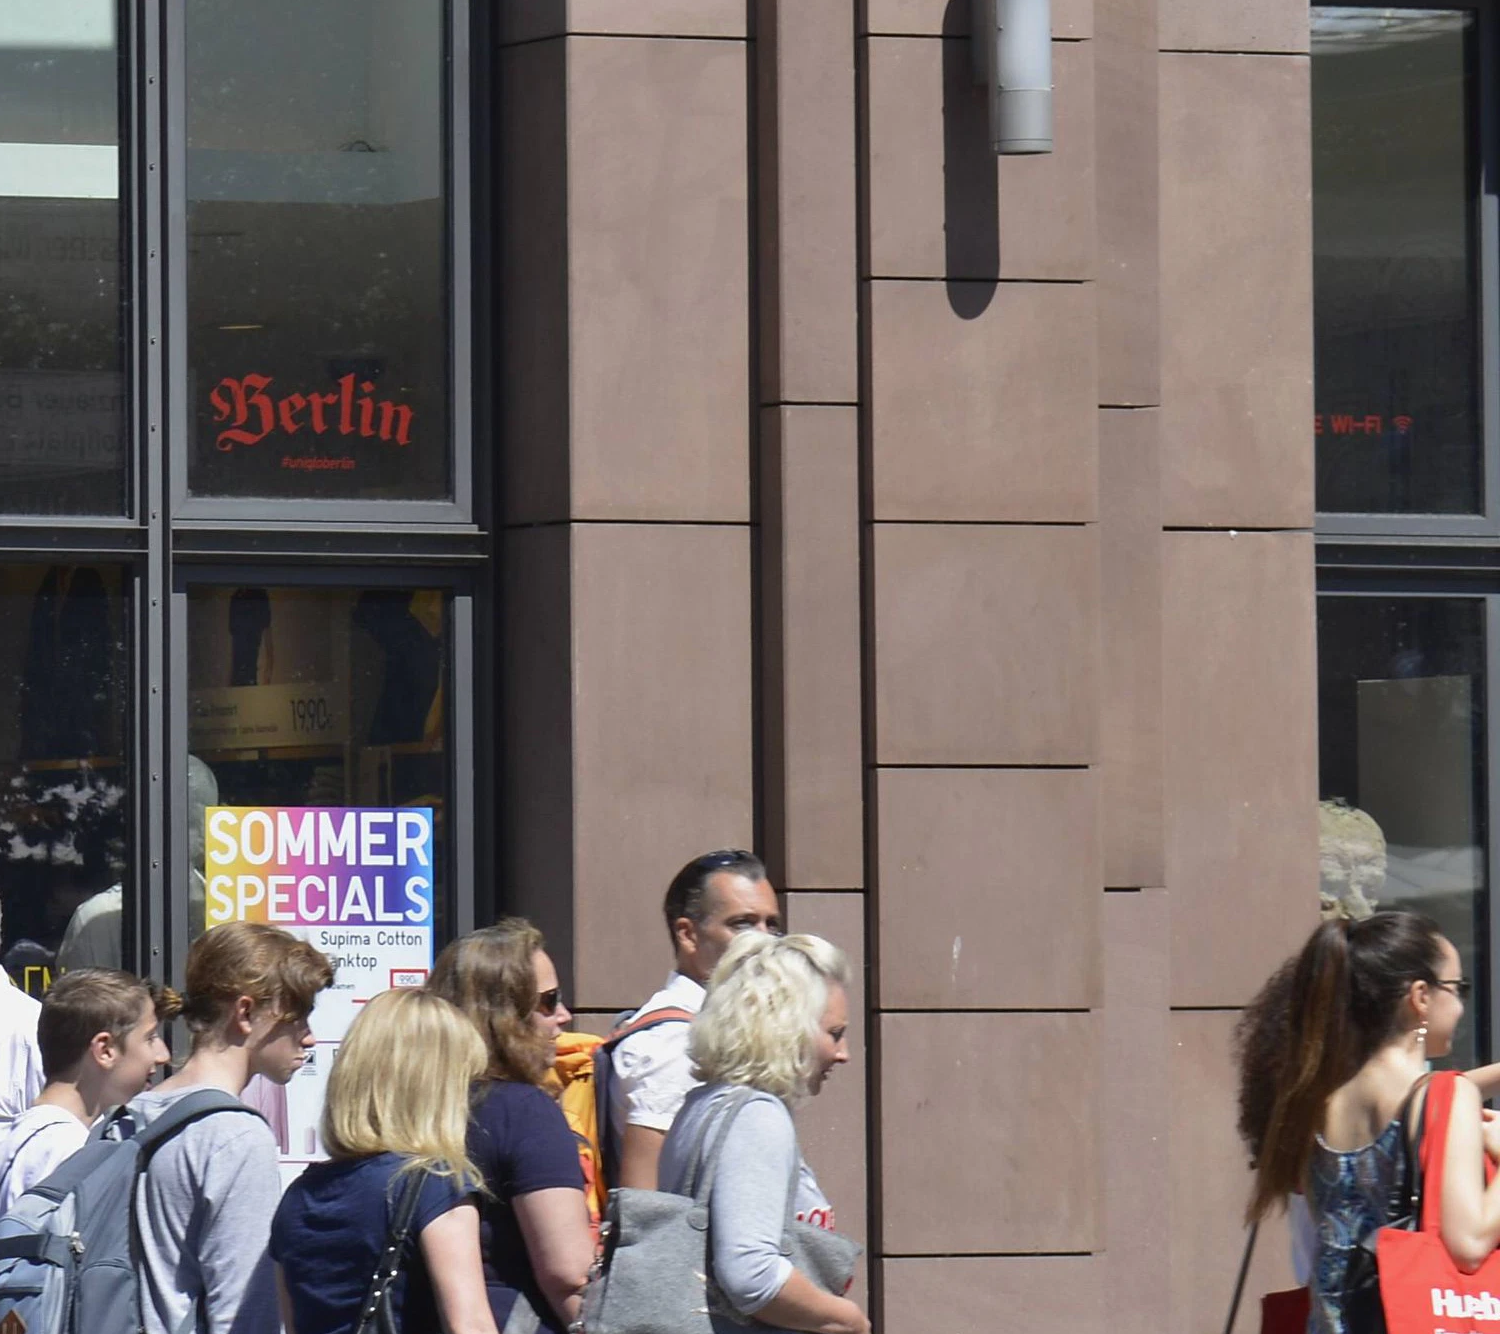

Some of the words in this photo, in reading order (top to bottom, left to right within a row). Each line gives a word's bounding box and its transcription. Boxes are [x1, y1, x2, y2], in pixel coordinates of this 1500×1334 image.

[209, 372, 414, 451] Berlin
[209, 810, 429, 866] SOMMER
[209, 875, 430, 923] SPECIALS
[320, 931, 371, 949] Supima
[376, 931, 423, 946] Cotton
[328, 953, 378, 971] anktop
